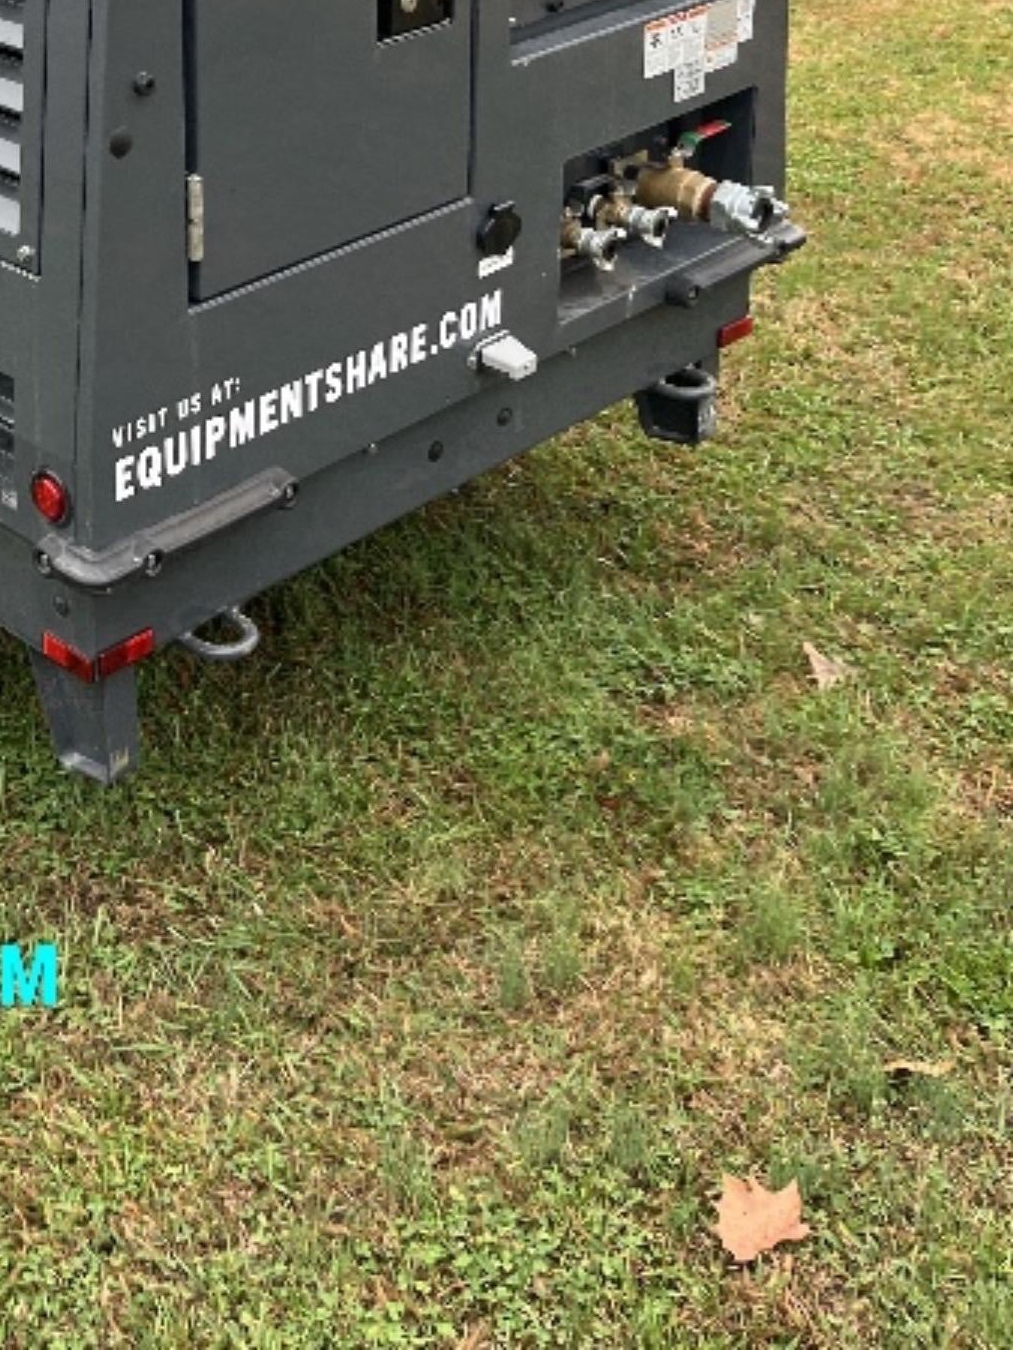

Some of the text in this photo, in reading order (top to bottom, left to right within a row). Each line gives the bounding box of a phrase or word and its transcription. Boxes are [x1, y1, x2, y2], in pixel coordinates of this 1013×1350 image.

[111, 376, 241, 448] VISIT US AT:
[114, 288, 504, 503] EQUIPMENTSHARE.COM
